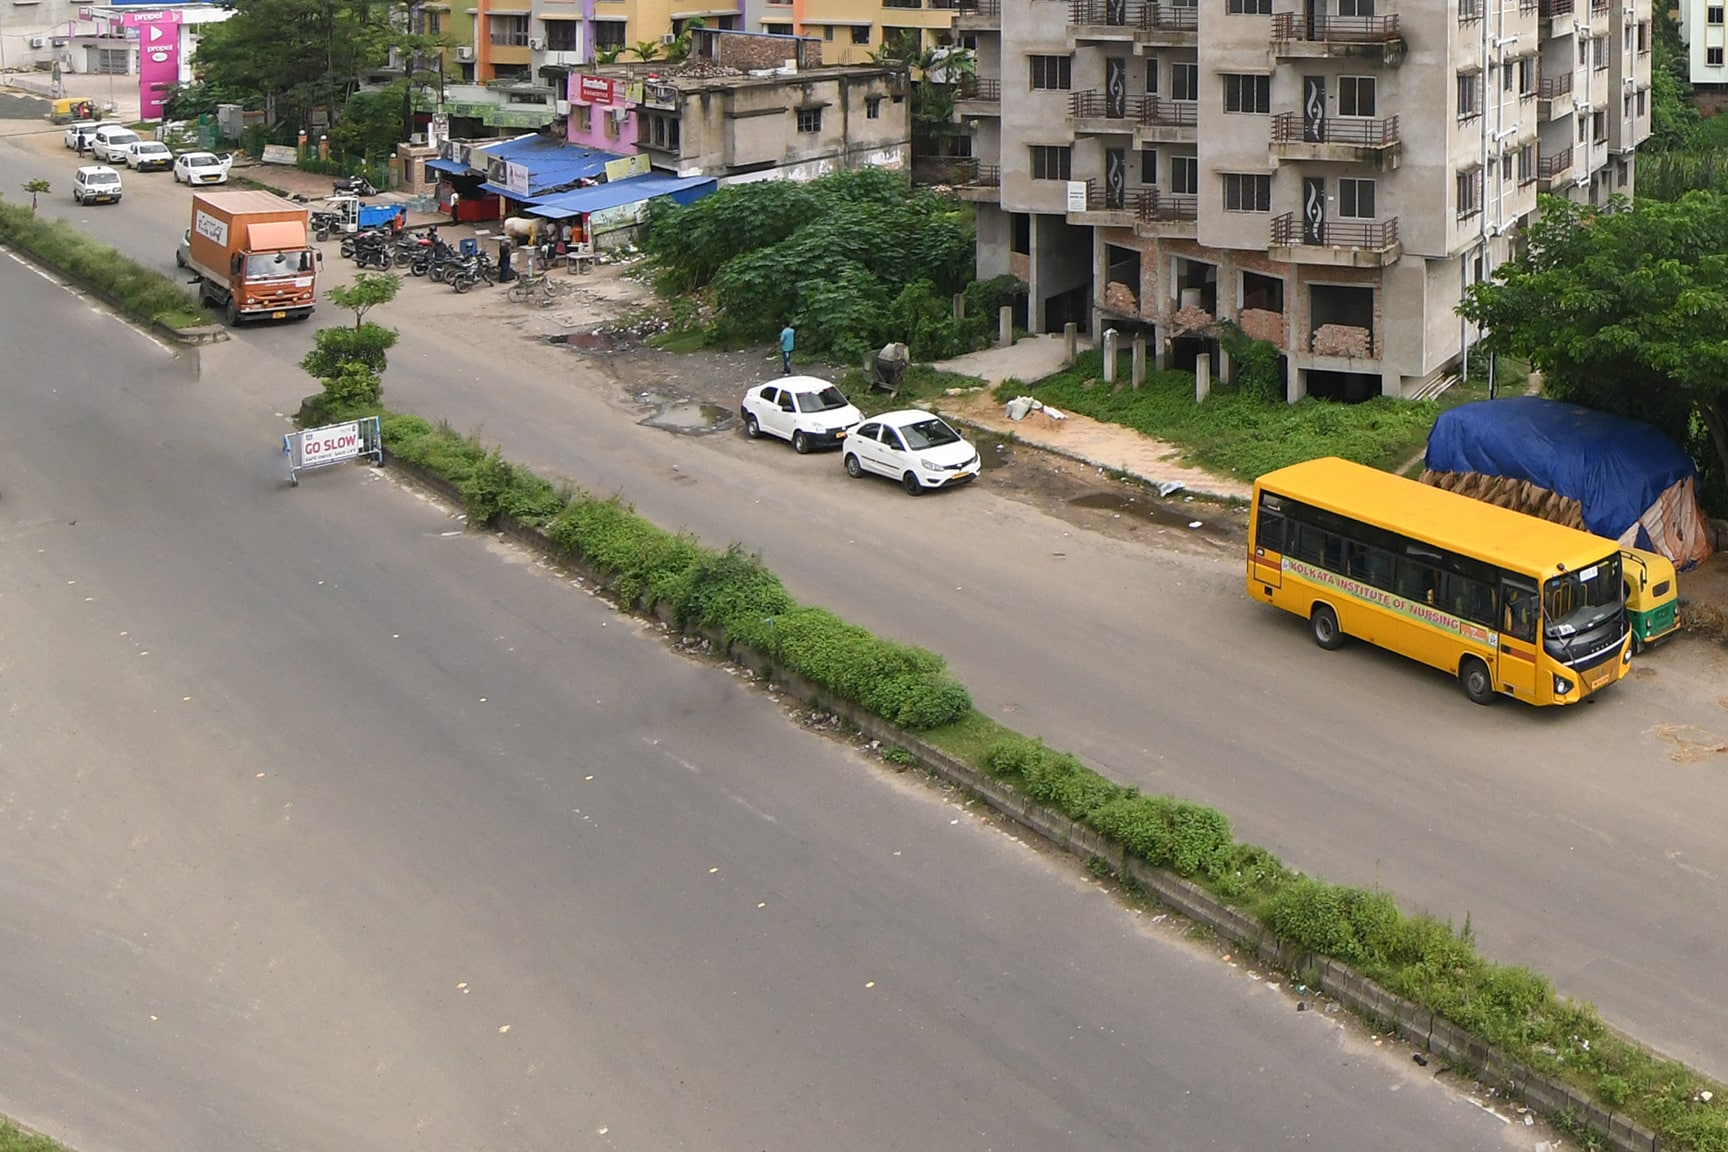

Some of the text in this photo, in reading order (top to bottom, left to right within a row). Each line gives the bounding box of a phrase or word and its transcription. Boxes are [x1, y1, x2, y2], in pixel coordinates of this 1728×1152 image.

[134, 11, 163, 22] propel
[147, 44, 173, 53] propel
[305, 434, 356, 455] GO SLOW
[1290, 561, 1335, 585] KOLKATA
[1337, 577, 1391, 605] INSTITUTE
[1393, 598, 1407, 610] OF
[1410, 604, 1459, 629] NURSING
